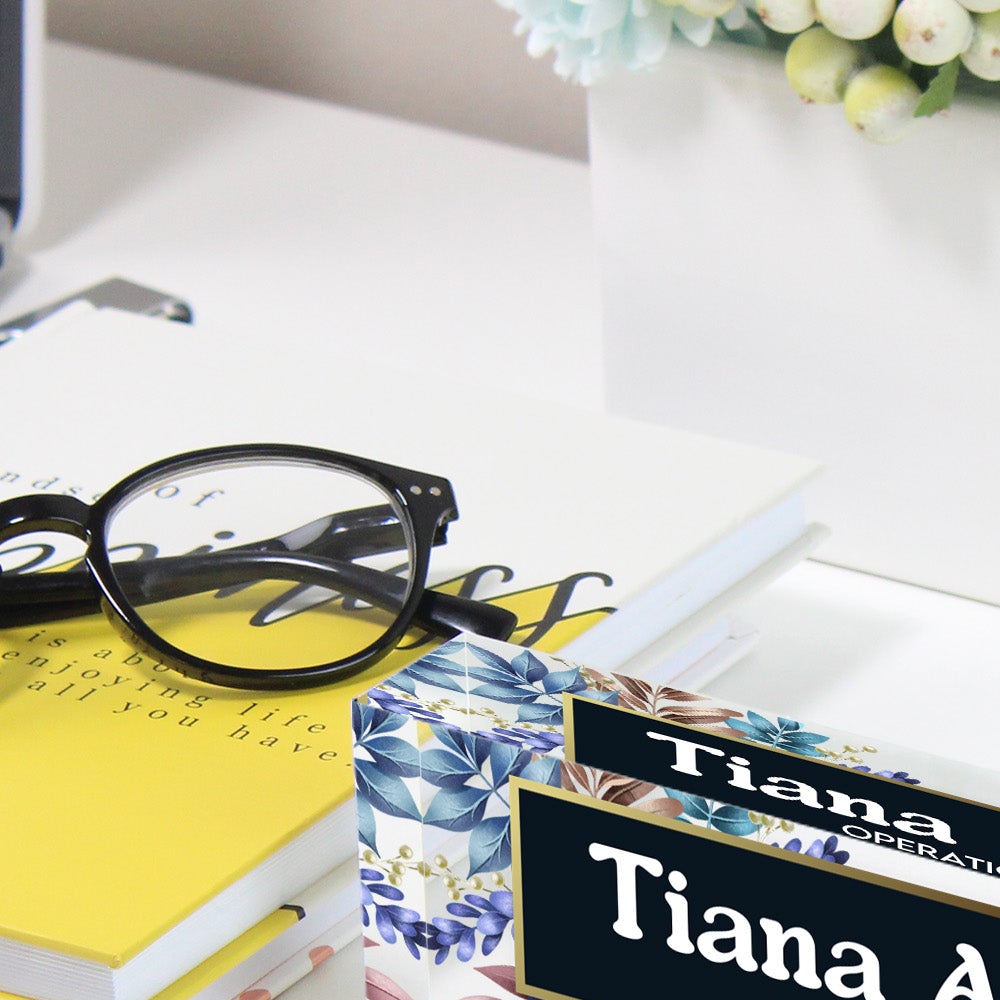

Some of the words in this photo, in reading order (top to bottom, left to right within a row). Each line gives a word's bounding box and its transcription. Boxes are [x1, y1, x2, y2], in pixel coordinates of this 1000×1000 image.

[154, 485, 225, 507] of
[26, 629, 67, 648] is
[1, 650, 212, 709] enjoying
[237, 702, 327, 734] life
[27, 680, 97, 701] all
[112, 701, 200, 727] you
[228, 724, 352, 767] have.
[646, 730, 958, 845] Tiana
